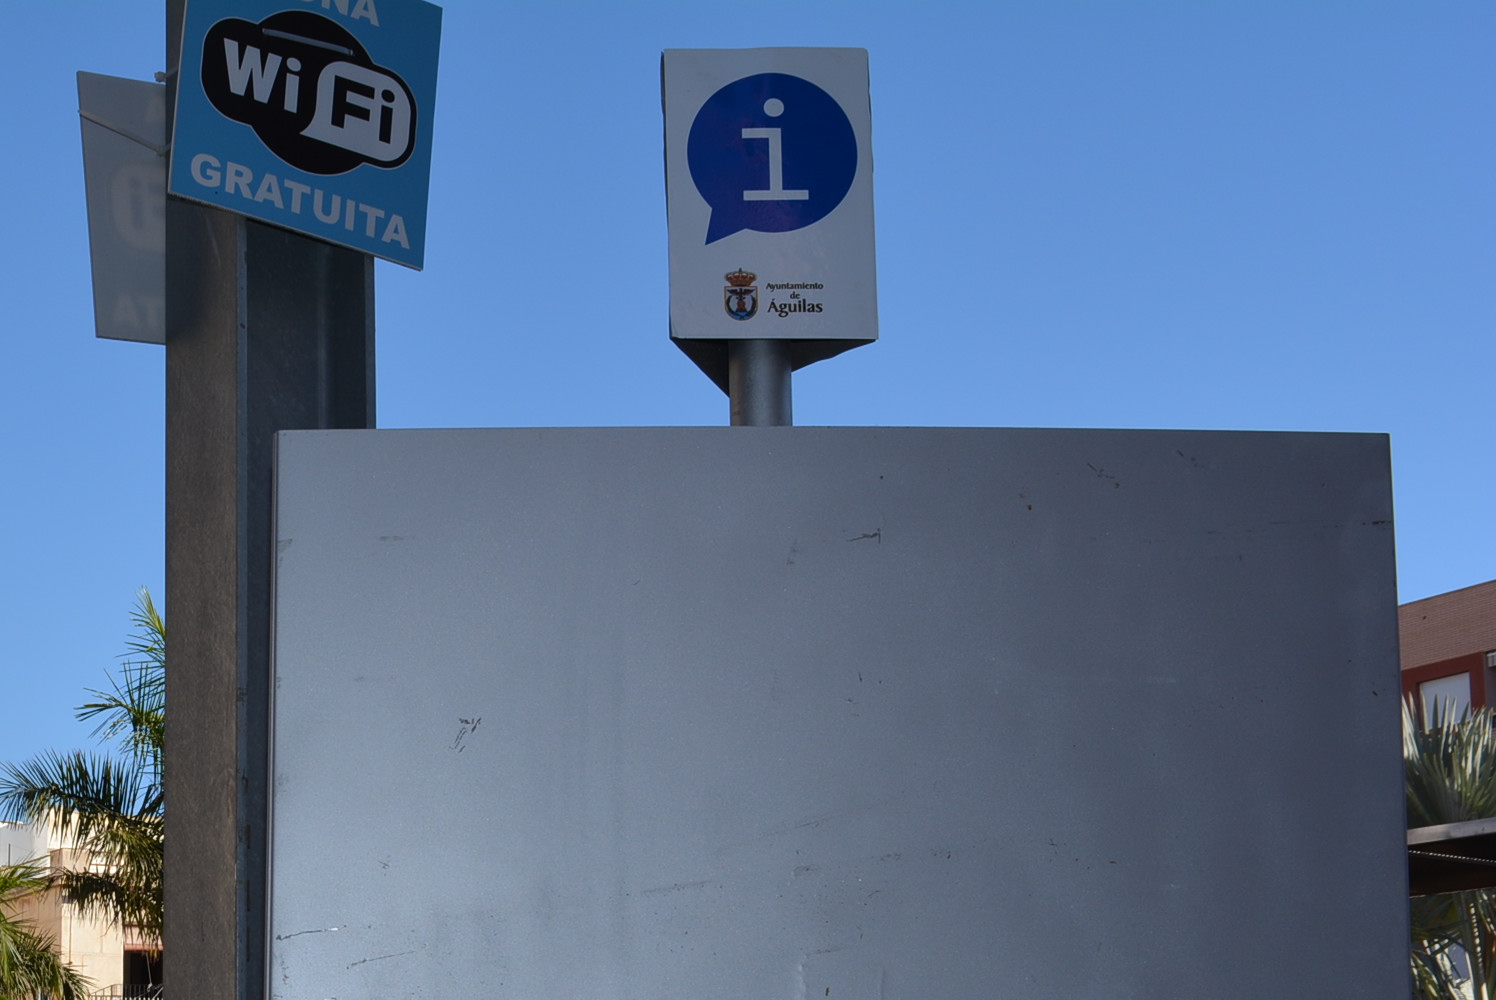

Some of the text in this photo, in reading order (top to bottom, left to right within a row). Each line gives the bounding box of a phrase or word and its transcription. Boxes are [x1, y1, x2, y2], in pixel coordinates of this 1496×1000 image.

[190, 152, 411, 250] GRATUITA
[765, 282, 824, 292] Ayuntamiento
[790, 290, 801, 299] de
[767, 298, 824, 318] Águilas
